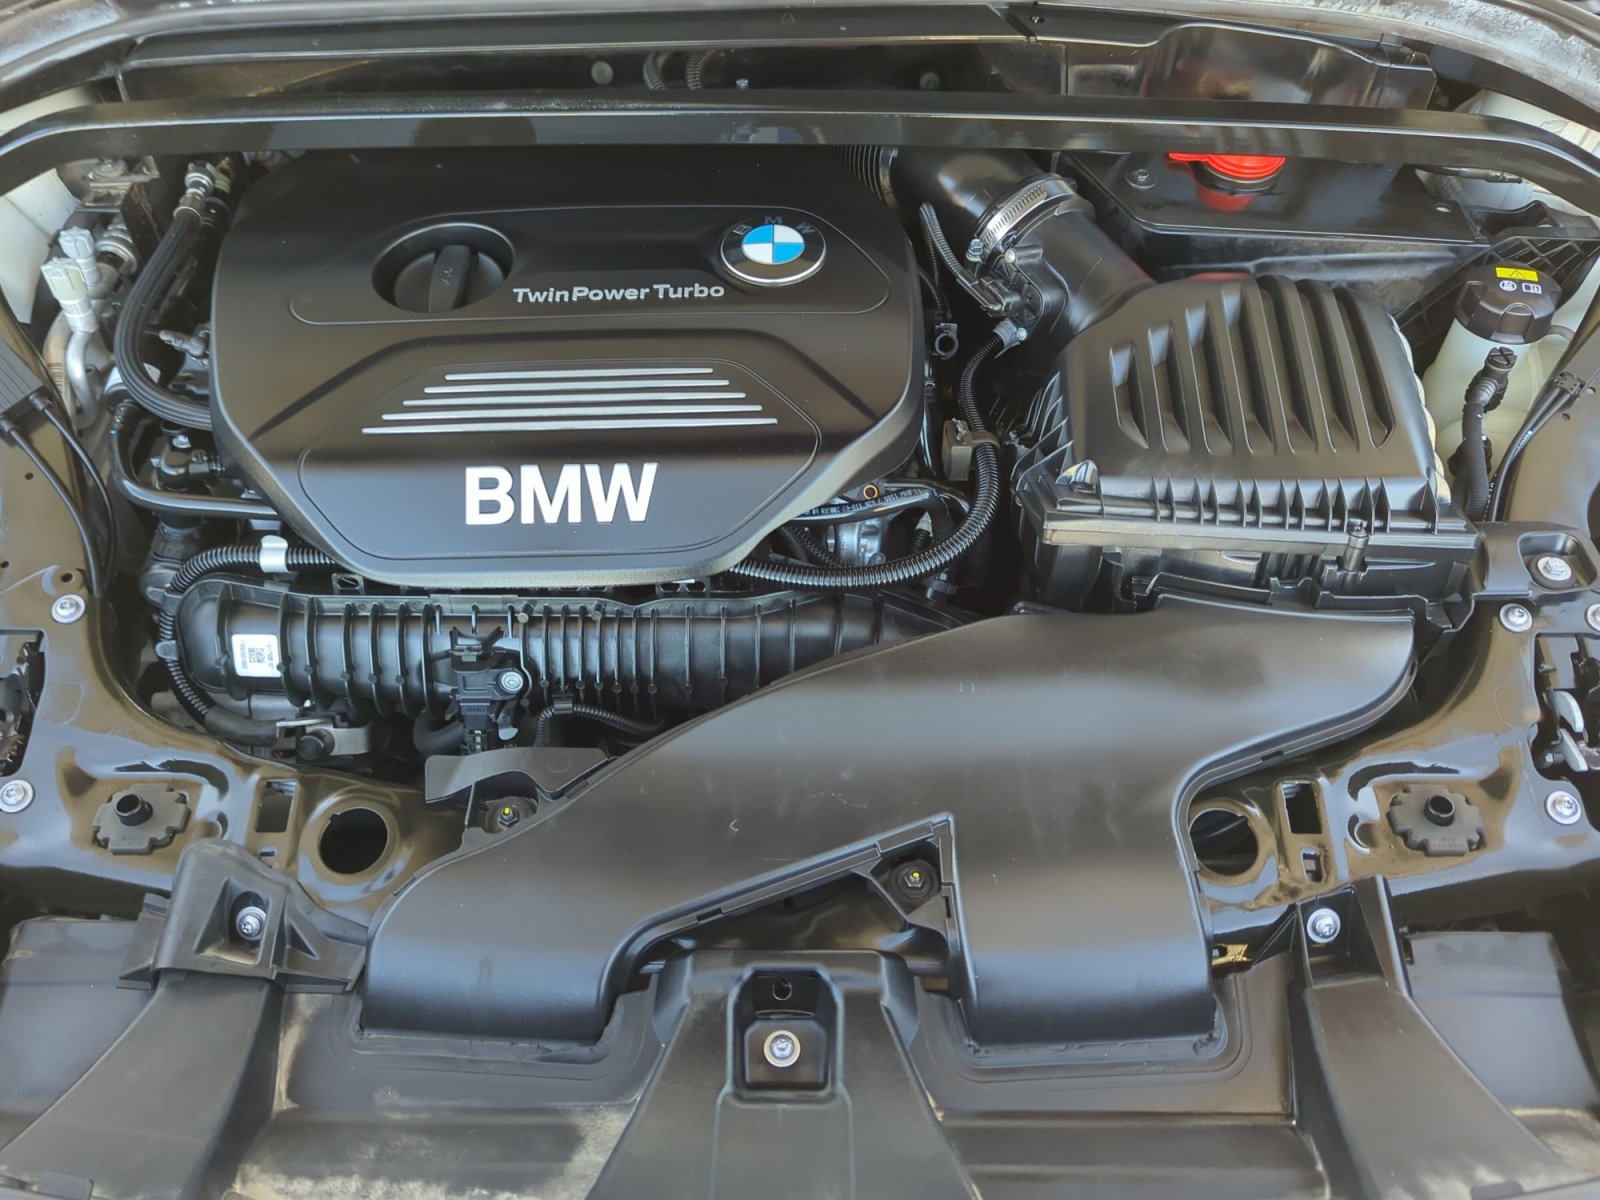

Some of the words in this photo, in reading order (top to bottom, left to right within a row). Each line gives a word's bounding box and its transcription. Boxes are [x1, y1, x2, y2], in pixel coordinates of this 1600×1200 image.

[733, 216, 815, 235] BMW
[653, 283, 725, 299] Turbo
[465, 462, 659, 525] BMW
